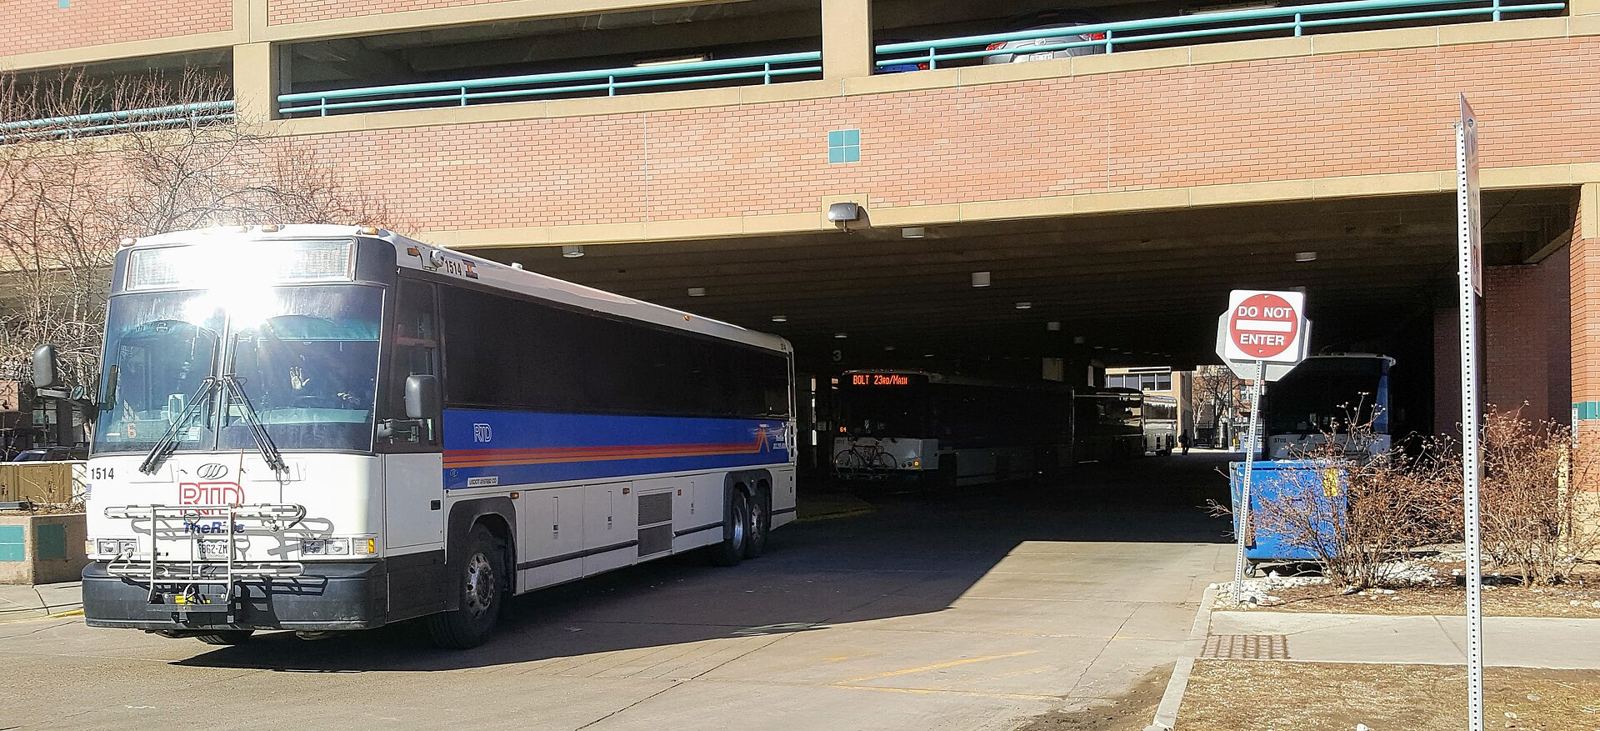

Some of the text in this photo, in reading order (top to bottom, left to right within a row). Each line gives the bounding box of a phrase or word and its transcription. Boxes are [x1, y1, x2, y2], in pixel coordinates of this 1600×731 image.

[445, 260, 462, 275] 1514
[1238, 306, 1293, 318] DO NOT
[1239, 333, 1285, 346] ENTER
[832, 350, 842, 362] 3
[852, 375, 870, 385] BOLT
[473, 423, 493, 443] RTD
[91, 467, 115, 480] 1514
[179, 481, 245, 515] RTD
